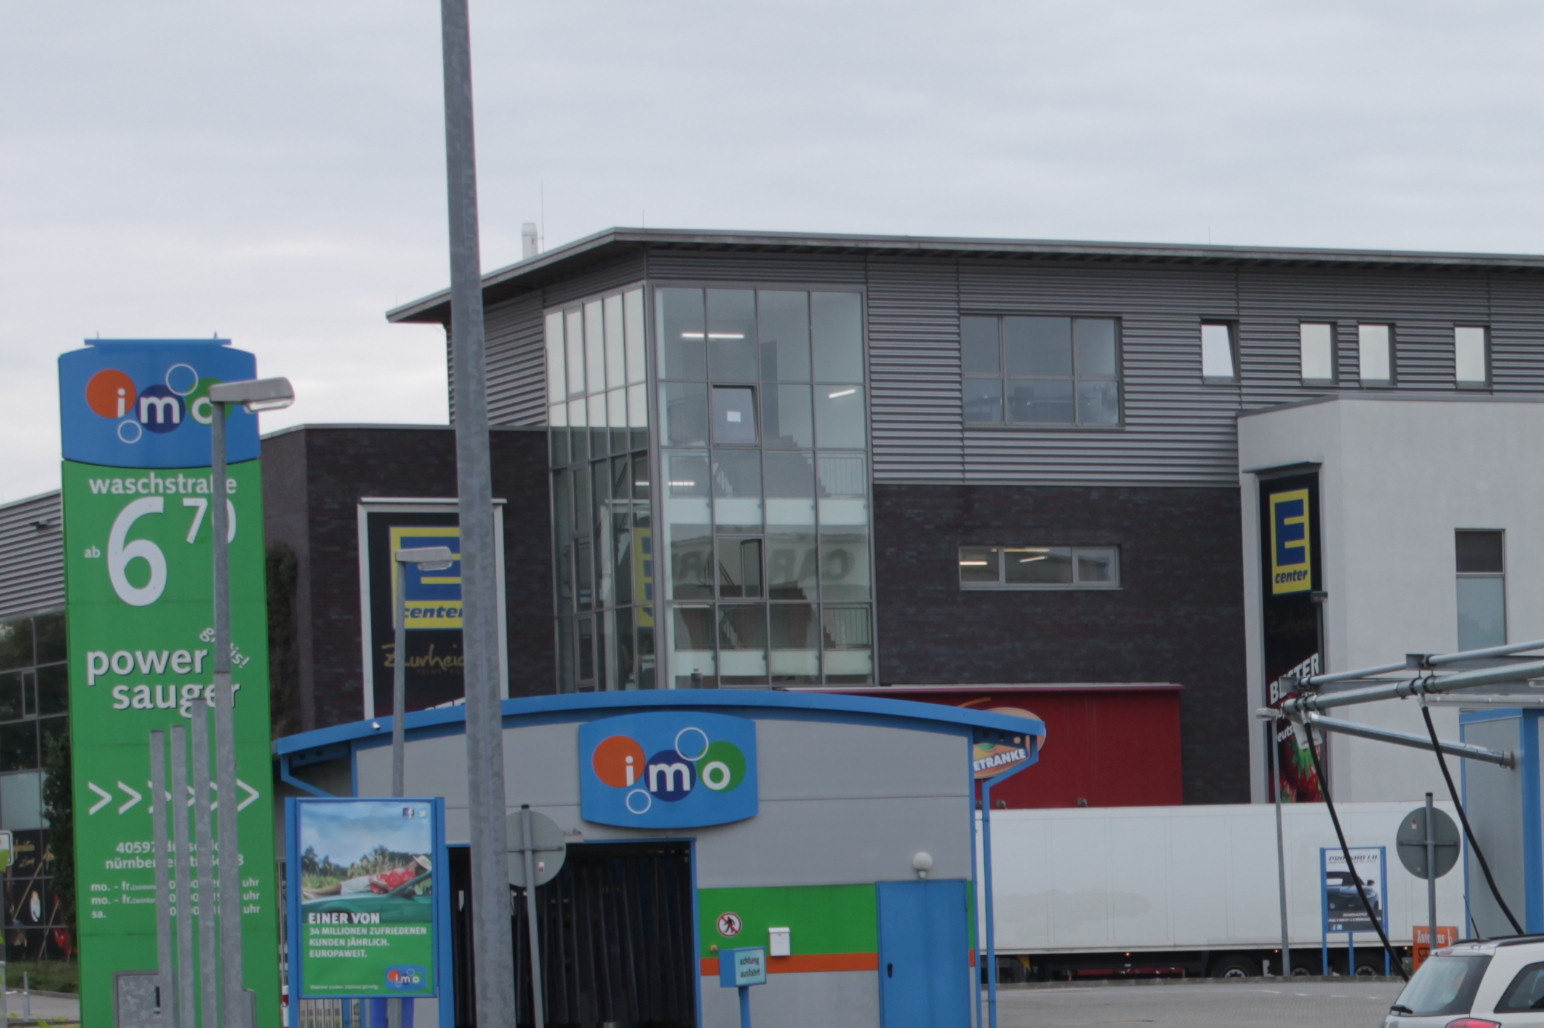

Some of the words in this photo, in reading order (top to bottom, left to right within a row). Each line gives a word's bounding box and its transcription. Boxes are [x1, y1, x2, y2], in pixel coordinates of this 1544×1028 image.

[89, 472, 238, 495] waschstrae
[1275, 498, 1306, 567] E
[83, 545, 101, 559] ab
[1275, 570, 1309, 584] center
[87, 649, 208, 685] power
[973, 748, 1026, 772] ETRANKE
[625, 755, 731, 793] imo
[90, 882, 111, 892] mo.
[242, 878, 260, 888] uhr
[91, 895, 111, 905] mo.
[242, 891, 260, 901] uhr
[91, 909, 107, 919] sa.
[243, 904, 261, 914] uhr
[308, 912, 349, 924] EINER
[350, 912, 380, 924] VON
[309, 927, 320, 936] 34
[321, 927, 368, 936] MILLIONEN
[369, 926, 428, 936] ZUFRIEDENEN
[309, 938, 346, 947] KUNDEN
[347, 936, 390, 948] JÄHRLICH.
[309, 949, 368, 959] EUROPAWEIT.
[395, 974, 421, 984] imo
